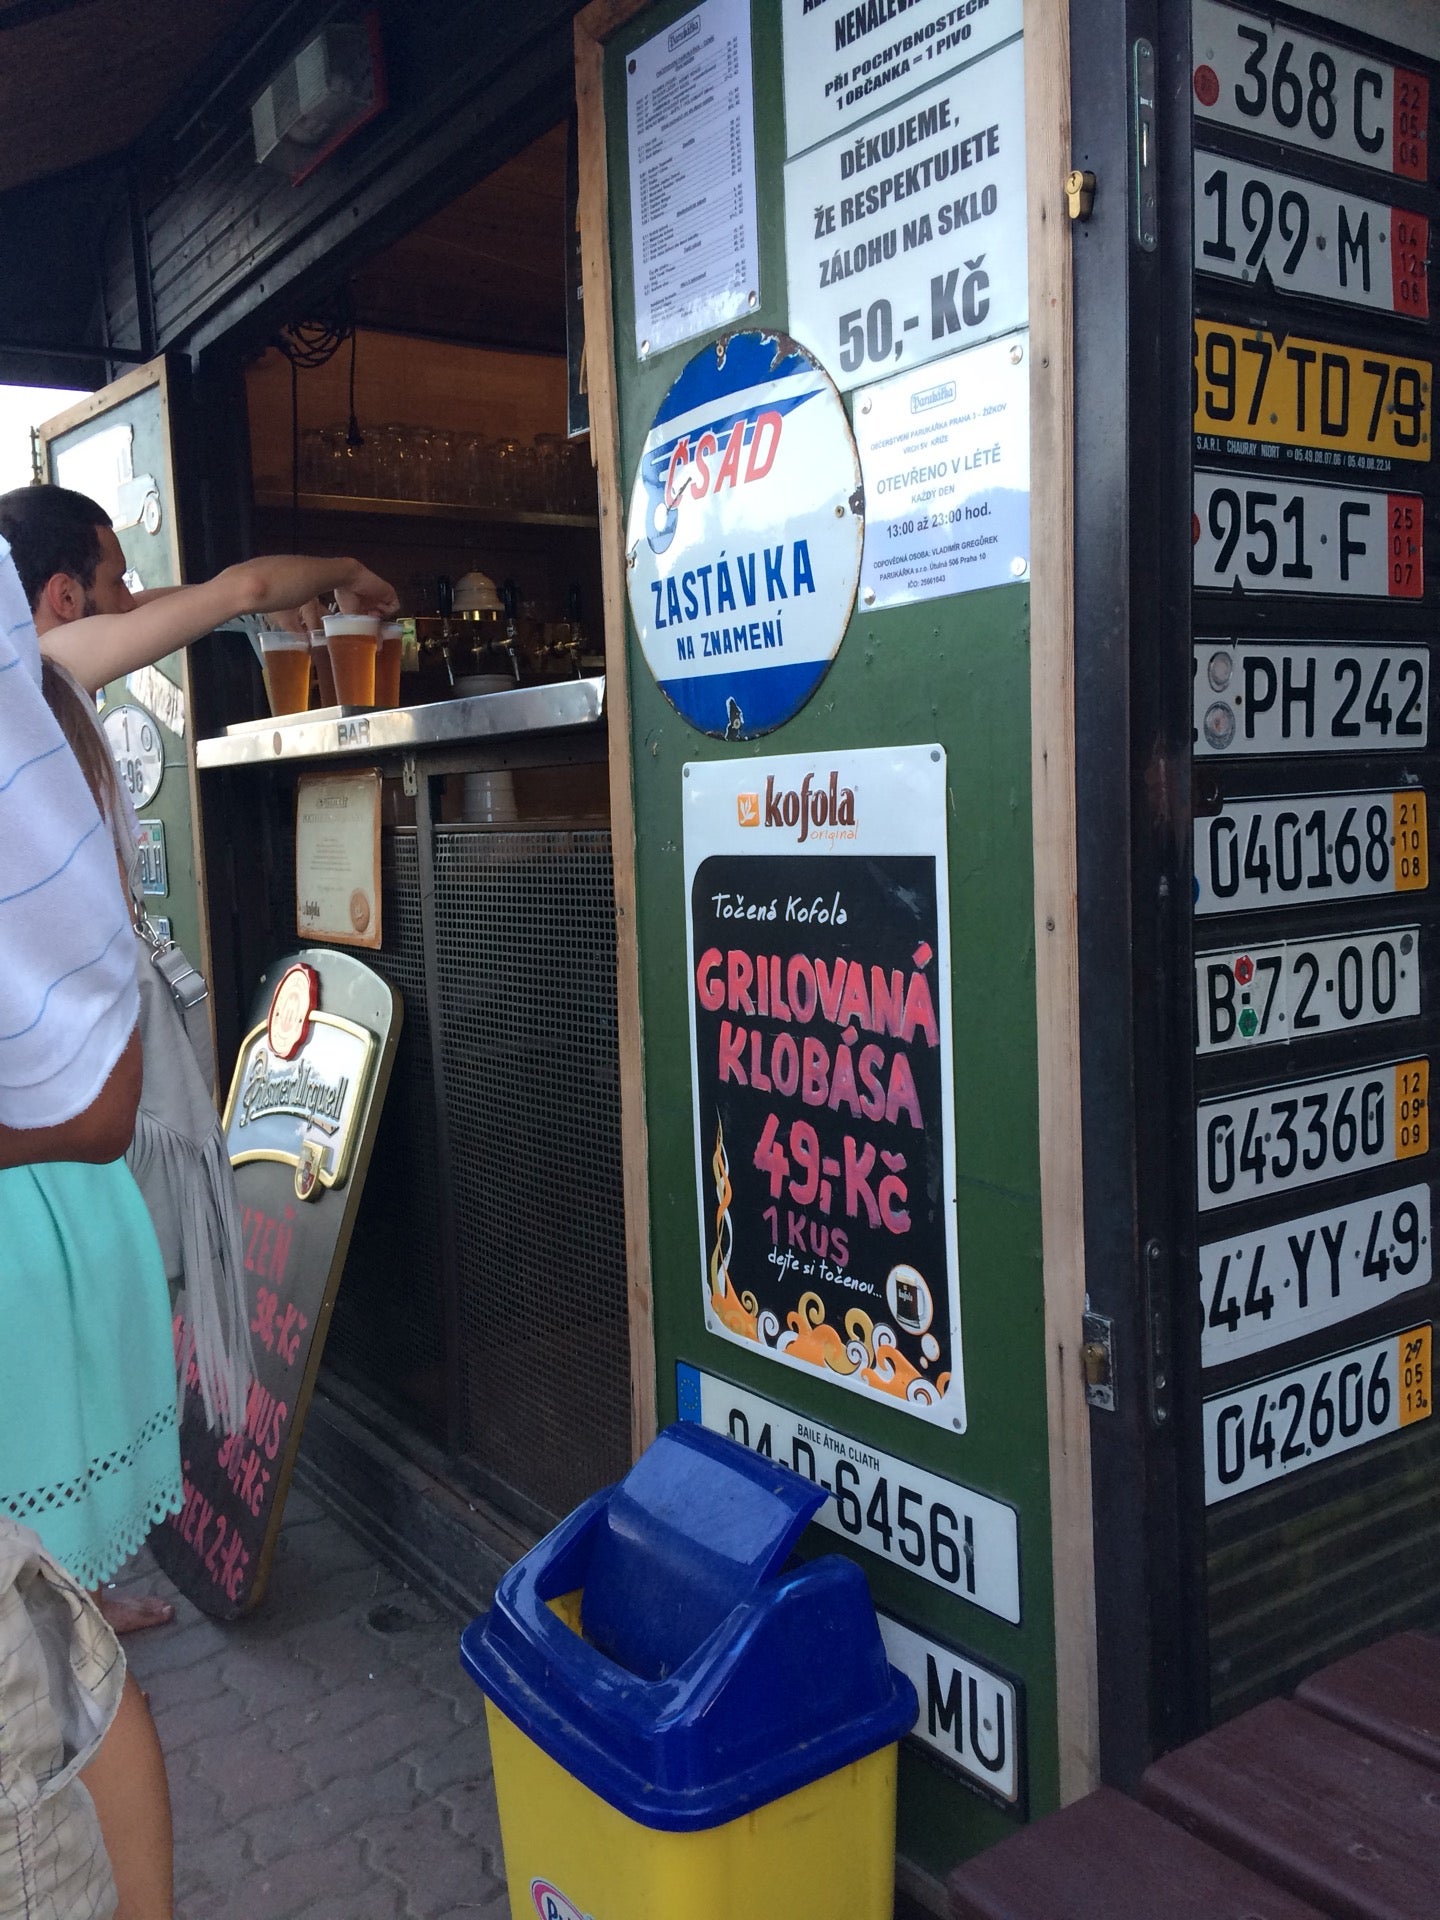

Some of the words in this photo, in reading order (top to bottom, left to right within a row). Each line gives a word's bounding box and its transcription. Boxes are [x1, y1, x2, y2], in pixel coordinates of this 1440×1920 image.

[834, 0, 924, 51] NENALE
[825, 73, 849, 98] PŘI
[836, 97, 843, 111] 1
[846, 59, 911, 107] OBČANKA
[925, 45, 933, 60] 1
[936, 24, 972, 55] PIVO
[1235, 23, 1337, 140] 368
[1353, 67, 1385, 154] C
[814, 205, 836, 240] ŽE
[840, 124, 1000, 227] RESPEKTUJETE
[819, 229, 897, 289] ZÁLOHU
[903, 213, 933, 252] NA
[938, 184, 998, 235] SKLO
[1202, 169, 1310, 275] 199
[1337, 204, 1371, 292] M
[839, 299, 919, 373] 50,-
[930, 253, 990, 340] KČ
[1194, 328, 1273, 426] 97
[1286, 346, 1351, 438] TD
[1362, 359, 1422, 448] 79
[664, 411, 783, 509] ČSAD
[876, 460, 948, 496] OTEVŘENO
[951, 457, 961, 474] V
[964, 443, 1001, 471] LÉTĚ
[1226, 439, 1257, 456] CHAURAY
[938, 484, 955, 497] DEN
[887, 520, 914, 539] 13:00
[917, 517, 929, 532] až
[931, 508, 962, 527] 23:00
[965, 501, 992, 520] hod.
[1208, 487, 1313, 580] 951
[1339, 501, 1371, 581] F
[1393, 508, 1413, 530] 25
[960, 554, 977, 565] Praha
[1393, 535, 1413, 558] 01
[650, 538, 816, 630] ZASTÁVKA
[1393, 563, 1413, 585] 07
[676, 636, 695, 661] NA
[701, 609, 784, 657] ZNAMENÍ
[1243, 656, 1317, 739] PH
[1331, 658, 1424, 738] 242
[337, 720, 371, 746] BAR
[764, 771, 856, 843] kofola
[1400, 803, 1418, 825] 21
[809, 820, 859, 850] original
[1208, 804, 1390, 899] 040168
[1400, 829, 1420, 851] 10
[1400, 856, 1421, 878] 08
[711, 892, 778, 921] Točená
[785, 891, 848, 926] Kofola
[697, 942, 940, 1049] GRILOVANÁ
[718, 1020, 925, 1130] KLOBÁSA
[1402, 1072, 1421, 1096] 12
[1400, 1098, 1421, 1121] 09
[1400, 1123, 1421, 1147] 09
[1207, 1081, 1385, 1195] 043360
[762, 1205, 778, 1246] 1
[788, 1210, 850, 1268] KUS
[767, 1246, 800, 1282] dejte
[802, 1259, 816, 1275] si
[1199, 1244, 1275, 1338] 44
[1287, 1220, 1348, 1309] YY
[1362, 1200, 1420, 1283] 49
[1404, 1363, 1423, 1387] 05
[1216, 1351, 1391, 1485] 042606
[1404, 1389, 1424, 1413] 13
[797, 1423, 821, 1445] BAILE
[823, 1433, 846, 1456] ÁTHA
[848, 1446, 880, 1472] CLIATH
[925, 1652, 1006, 1773] MU
